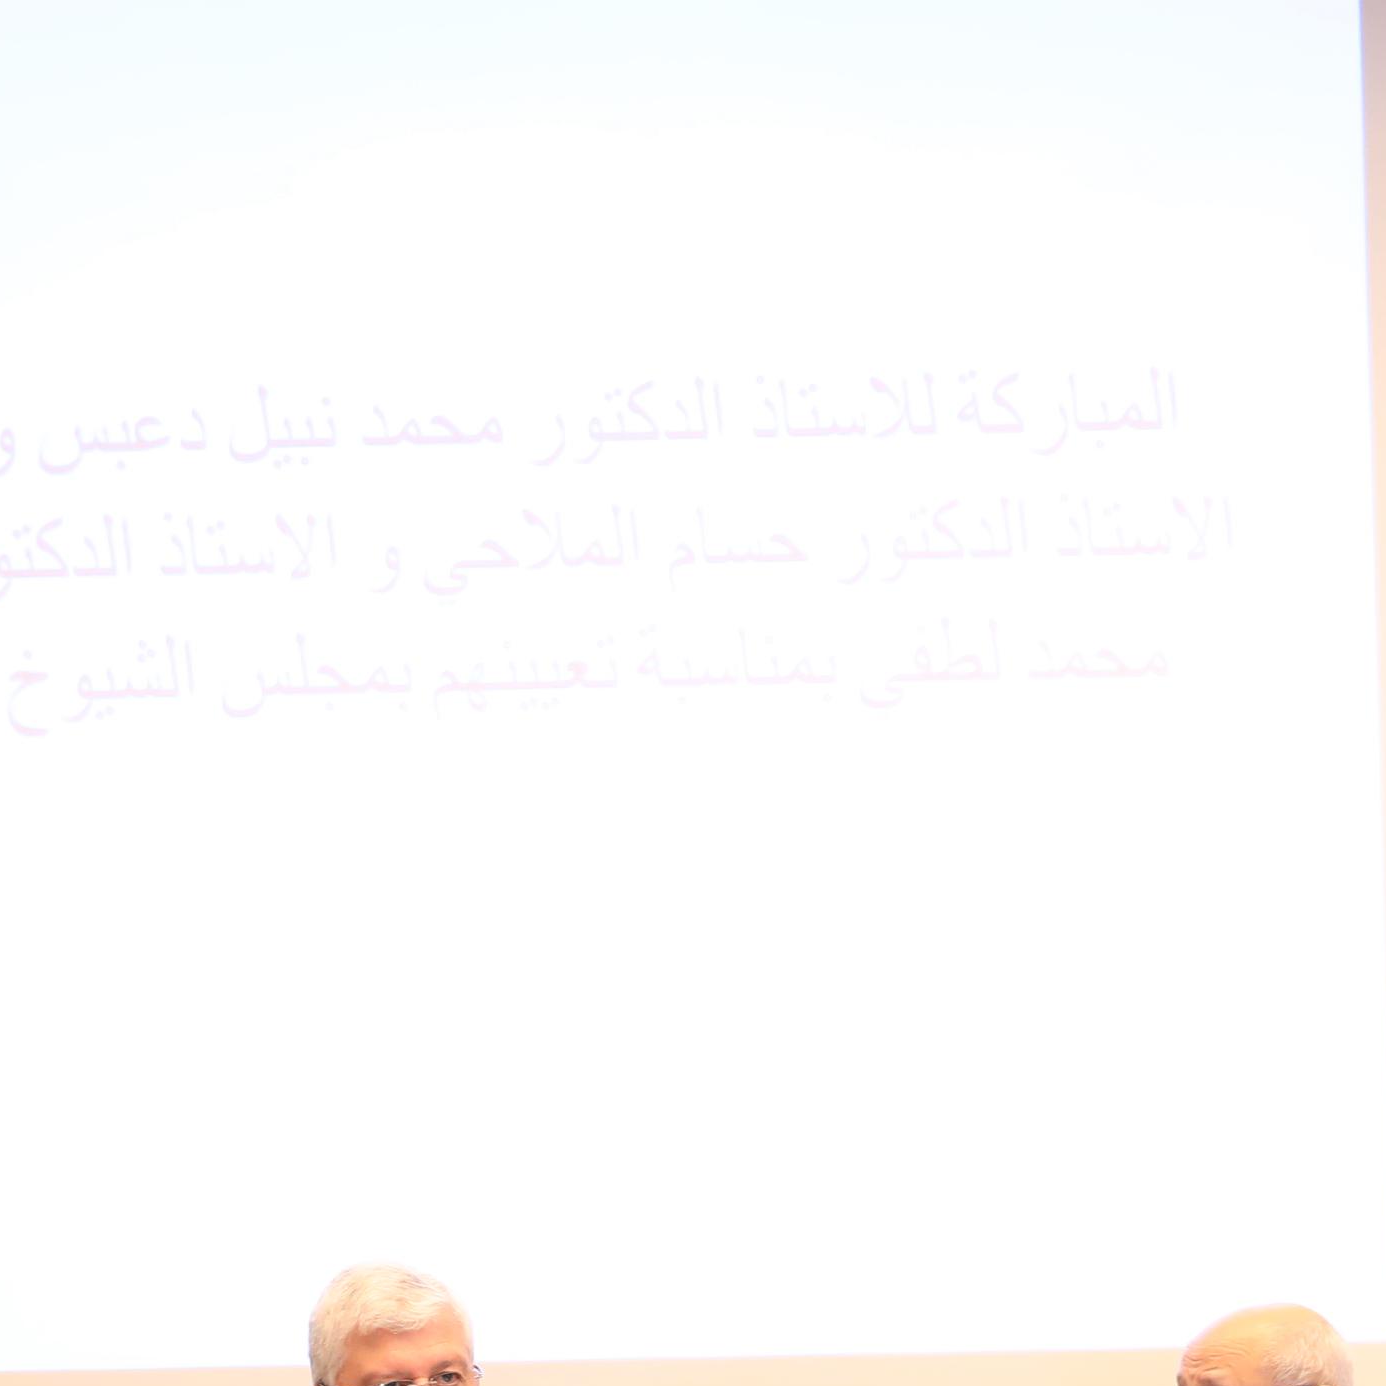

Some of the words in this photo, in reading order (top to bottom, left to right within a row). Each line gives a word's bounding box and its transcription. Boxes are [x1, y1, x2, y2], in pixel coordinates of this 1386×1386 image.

[38, 408, 206, 475] دعبس
[229, 384, 336, 469] نبيل
[362, 406, 503, 446] محمد
[533, 376, 722, 466] الدكتور
[754, 373, 936, 438] للاستاذ
[957, 367, 1177, 456] المباركة
[160, 513, 335, 579] الاستاذ
[373, 546, 400, 593] و
[424, 506, 637, 604] الملاحي
[669, 506, 807, 591] حسام
[839, 496, 1026, 584] الدكتور
[1058, 496, 1231, 560] الاستاذ
[8, 635, 193, 737] الشيوخ
[223, 633, 411, 718] بمجلس
[433, 634, 618, 718] تعيينهم
[637, 624, 837, 704] بمناسبة
[861, 617, 1001, 717] لطفي
[1029, 640, 1169, 680] محمد
